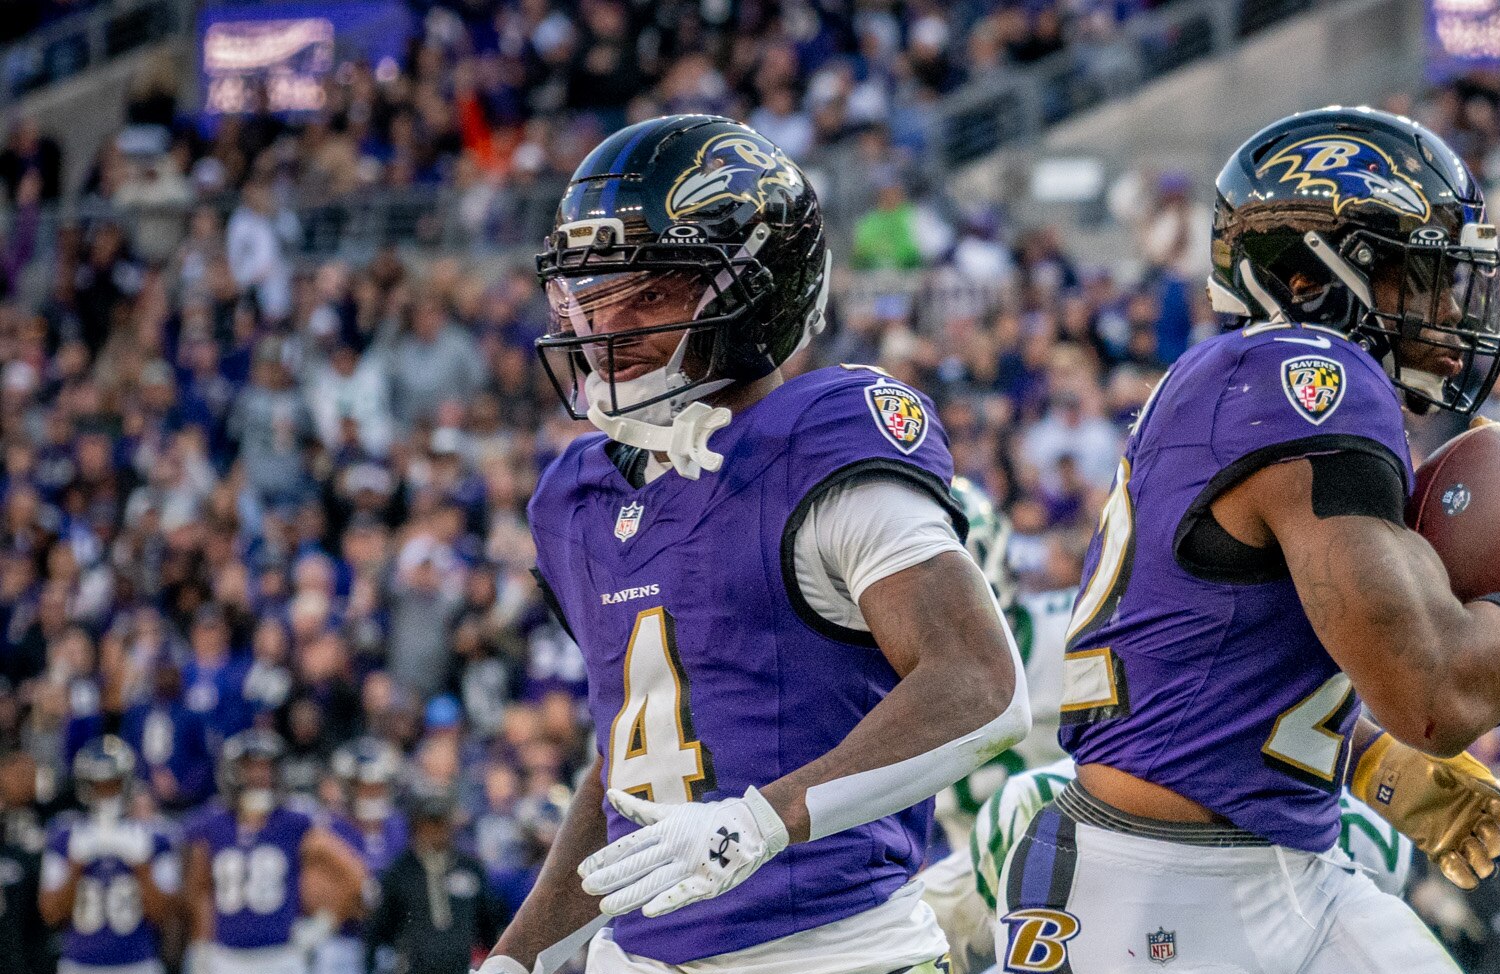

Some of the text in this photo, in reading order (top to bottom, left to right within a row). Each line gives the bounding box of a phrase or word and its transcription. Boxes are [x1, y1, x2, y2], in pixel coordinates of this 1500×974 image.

[1301, 141, 1361, 171] B
[661, 236, 706, 244] OAKLEY
[1411, 237, 1449, 246] OAKLEY
[1289, 361, 1337, 371] RAVENS
[601, 584, 660, 605] RAVENS
[607, 605, 706, 803] 4
[1378, 787, 1391, 801] 22
[1000, 907, 1081, 974] B
[1151, 944, 1173, 958] NFL
